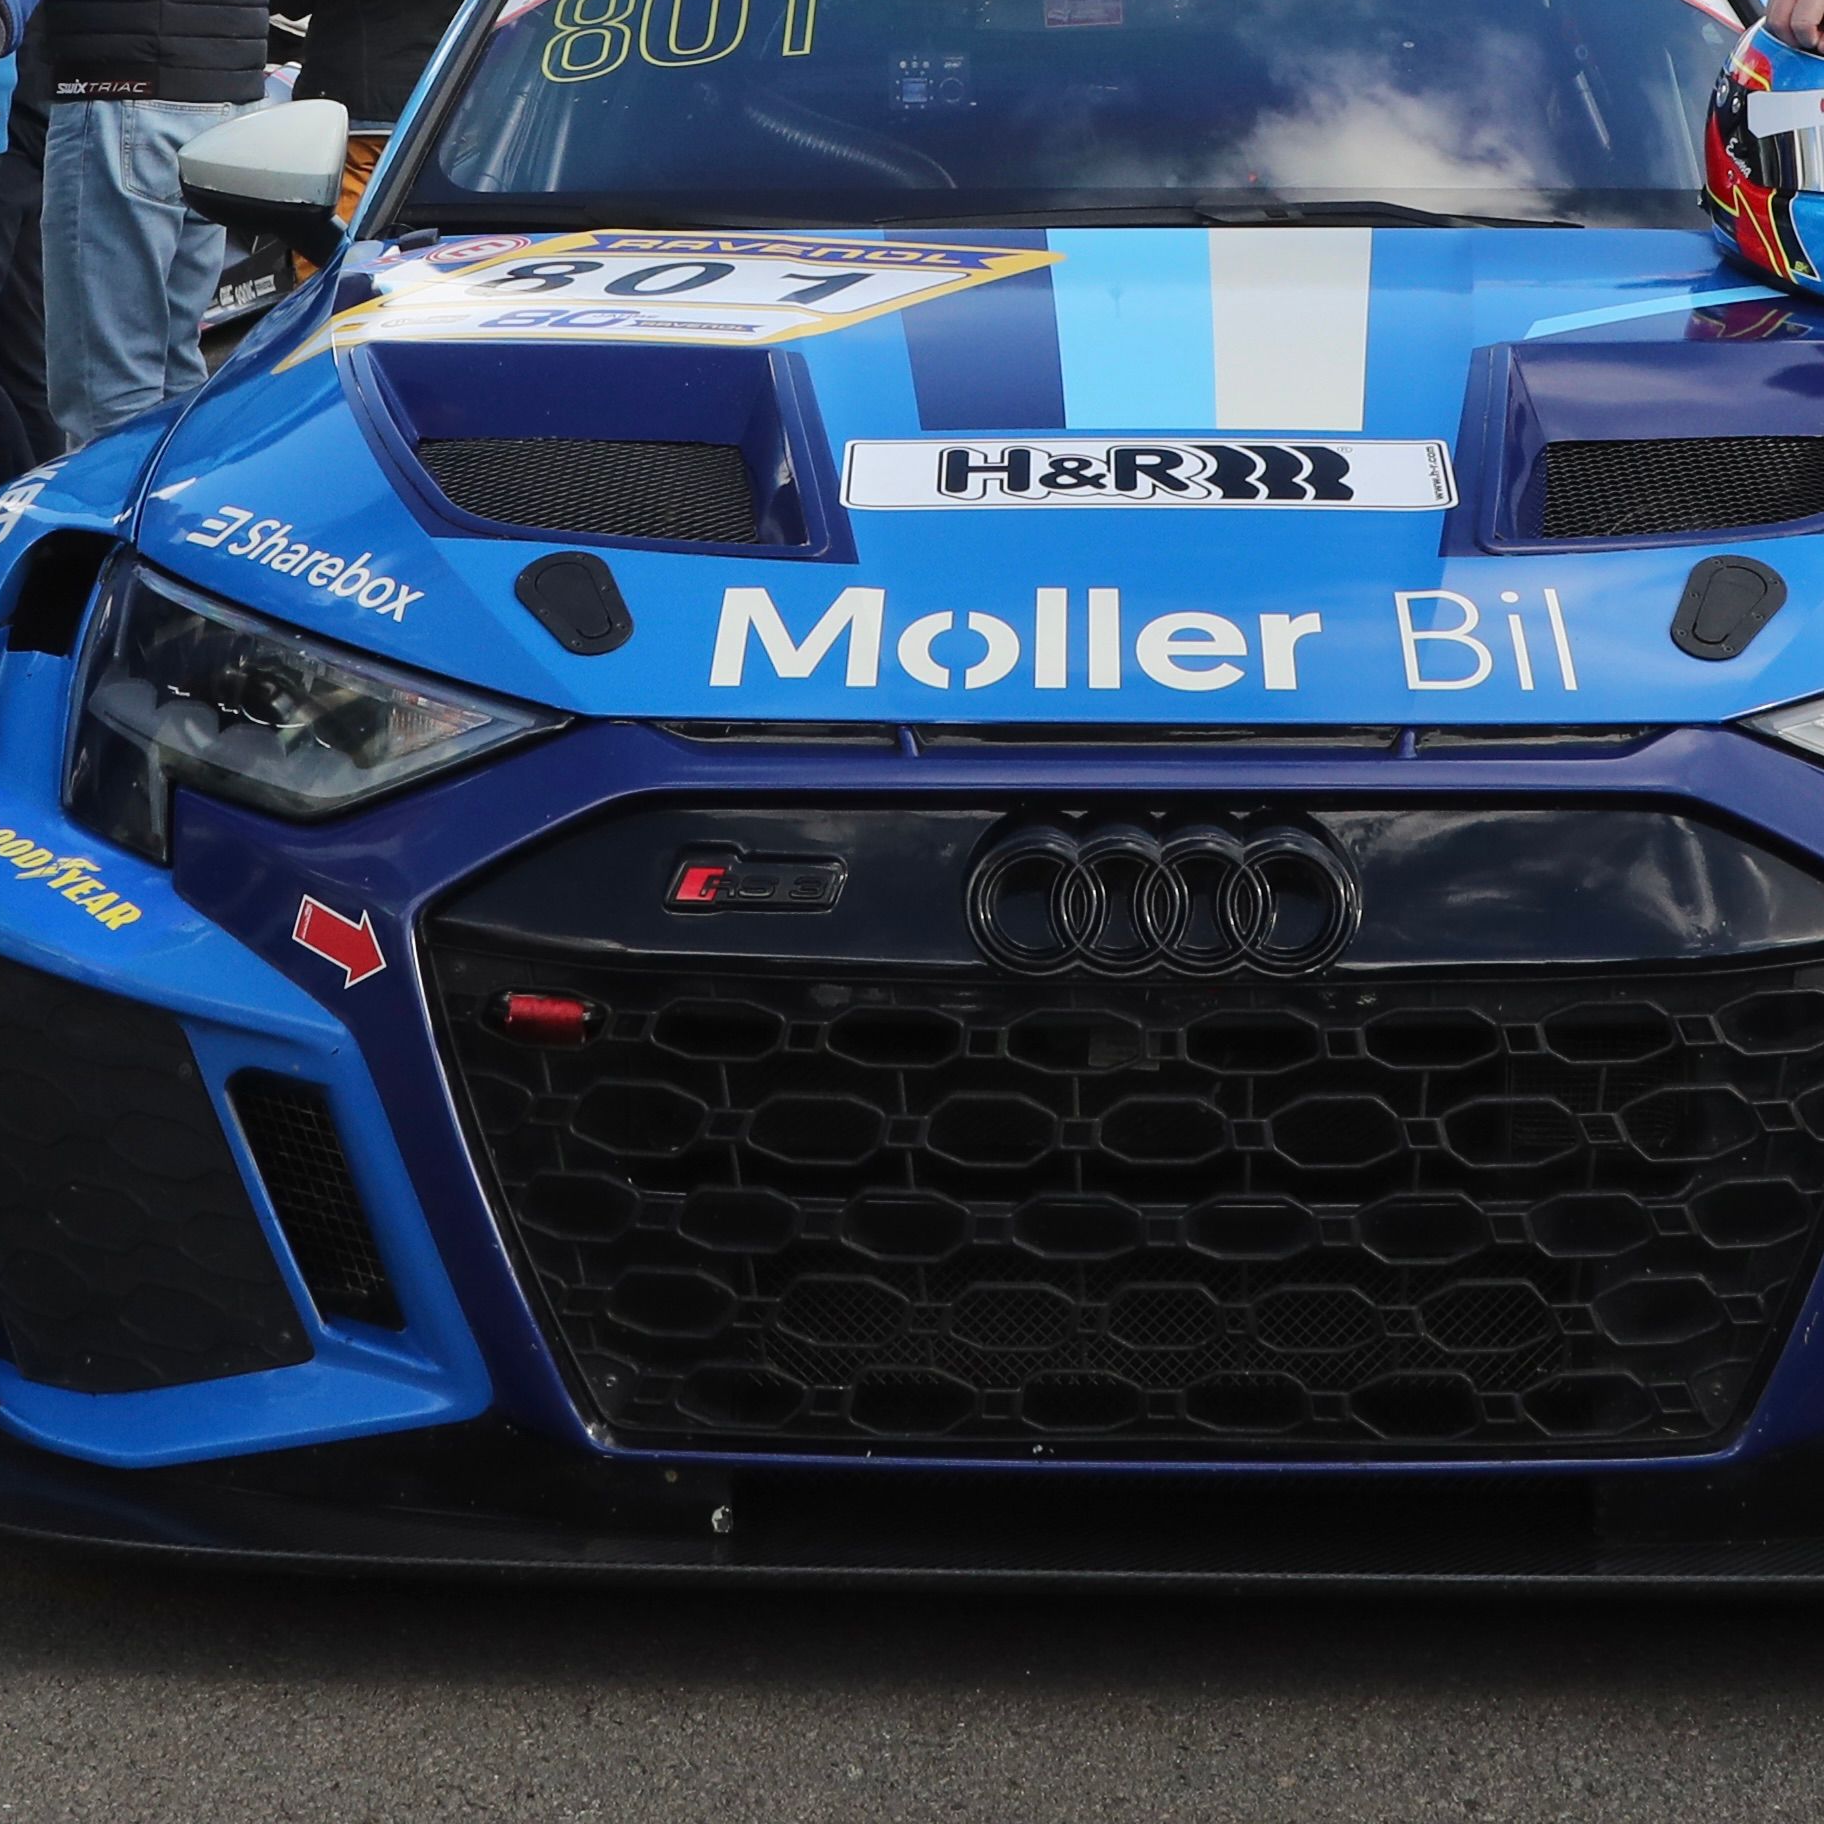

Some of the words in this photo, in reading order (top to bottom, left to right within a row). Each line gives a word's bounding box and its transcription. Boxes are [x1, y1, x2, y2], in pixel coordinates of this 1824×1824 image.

[609, 238, 966, 268] RAVENOL
[465, 260, 876, 305] 801
[478, 308, 629, 330] 80
[635, 319, 756, 334] RAVENOL
[940, 445, 1210, 500] H&R
[227, 517, 424, 624] Sharebox
[1393, 586, 1580, 692] Bil
[699, 873, 781, 900] RS
[788, 874, 829, 900] 3
